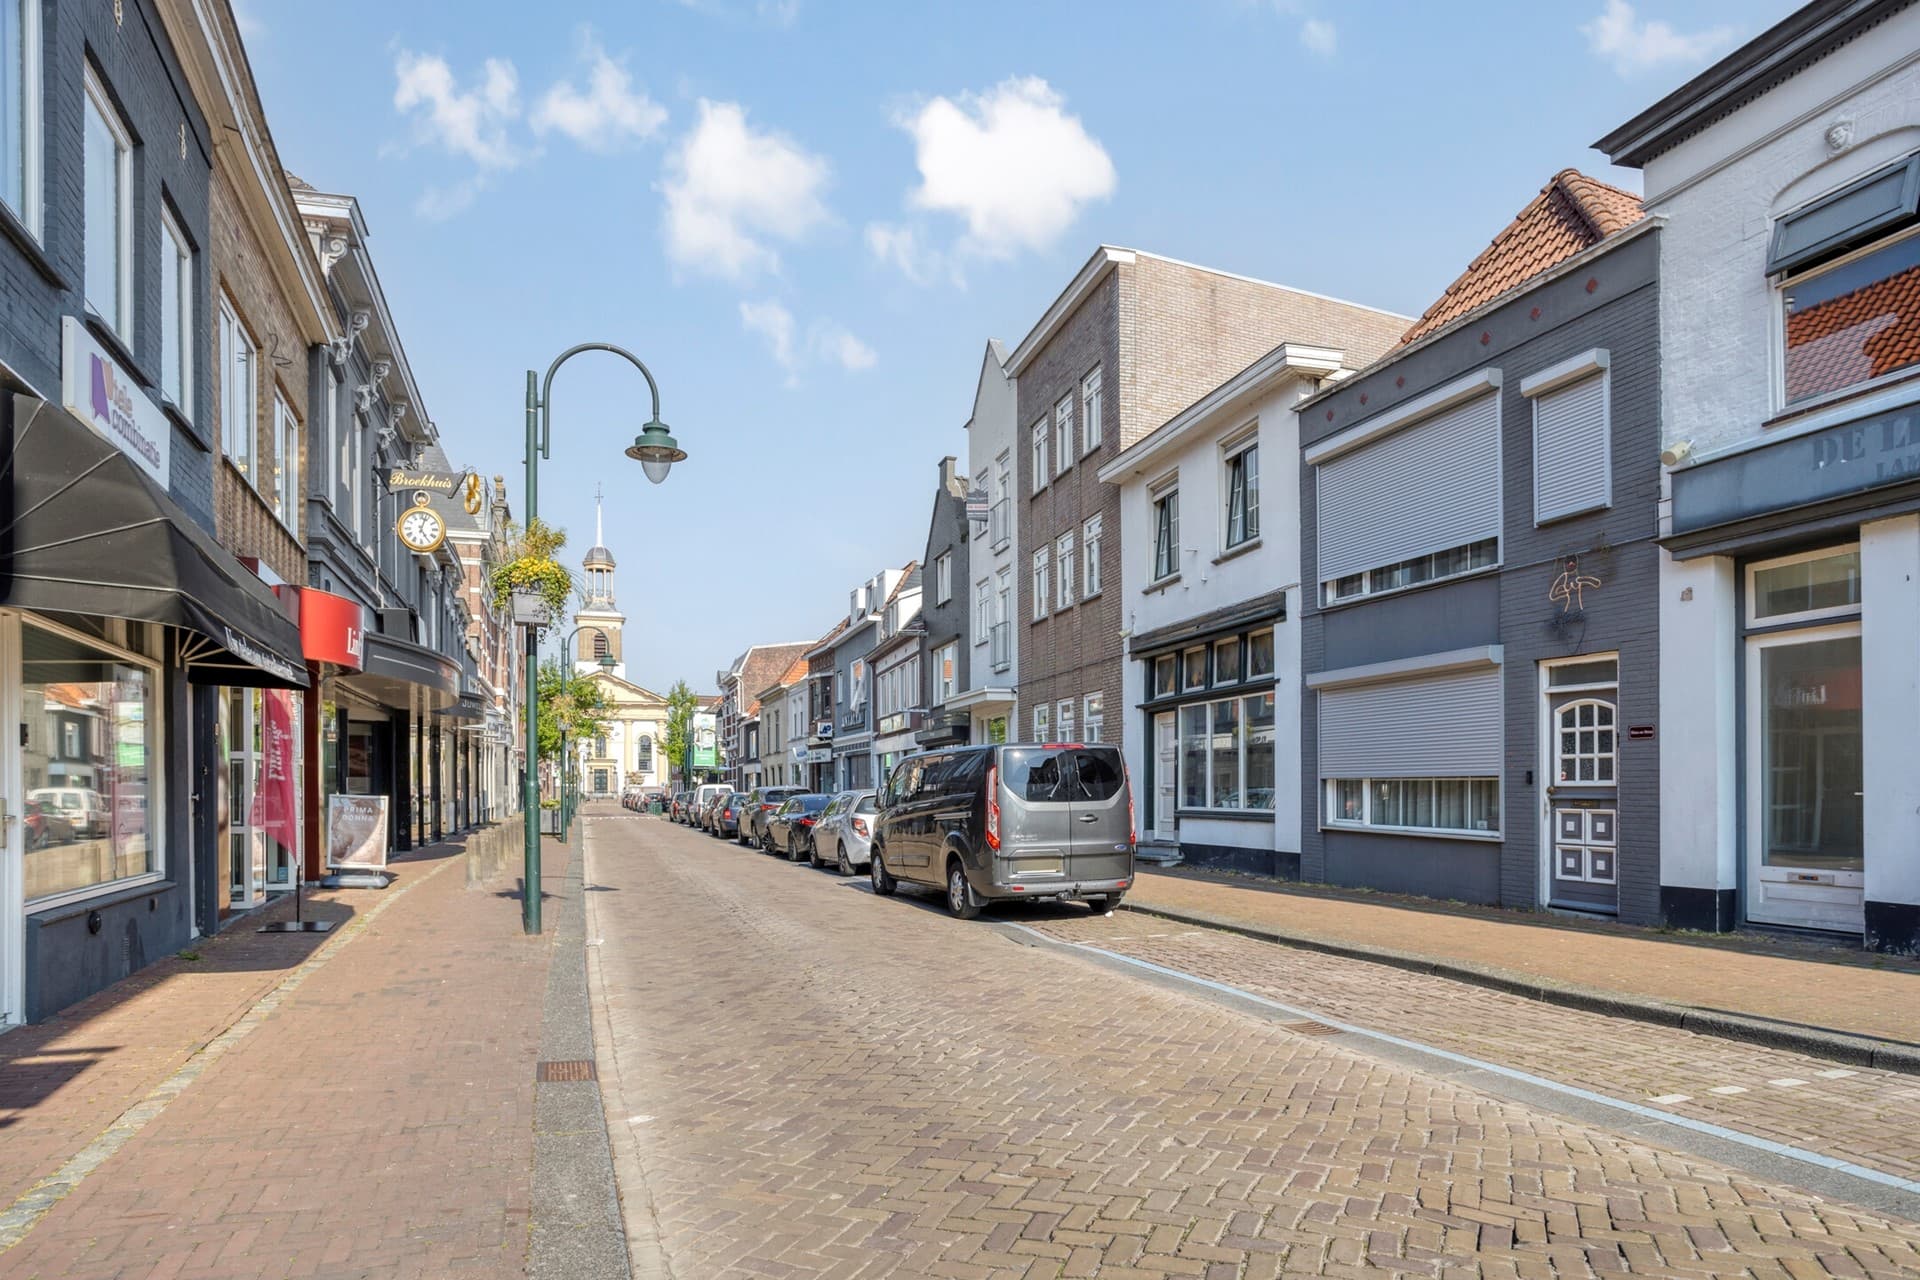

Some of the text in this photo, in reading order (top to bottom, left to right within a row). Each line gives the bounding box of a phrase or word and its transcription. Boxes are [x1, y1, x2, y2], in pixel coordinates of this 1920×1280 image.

[113, 384, 133, 419] tele
[112, 409, 160, 470] combinatie
[1811, 427, 1865, 472] DE
[390, 471, 452, 489] Broekhuis
[344, 806, 374, 815] PRIMA
